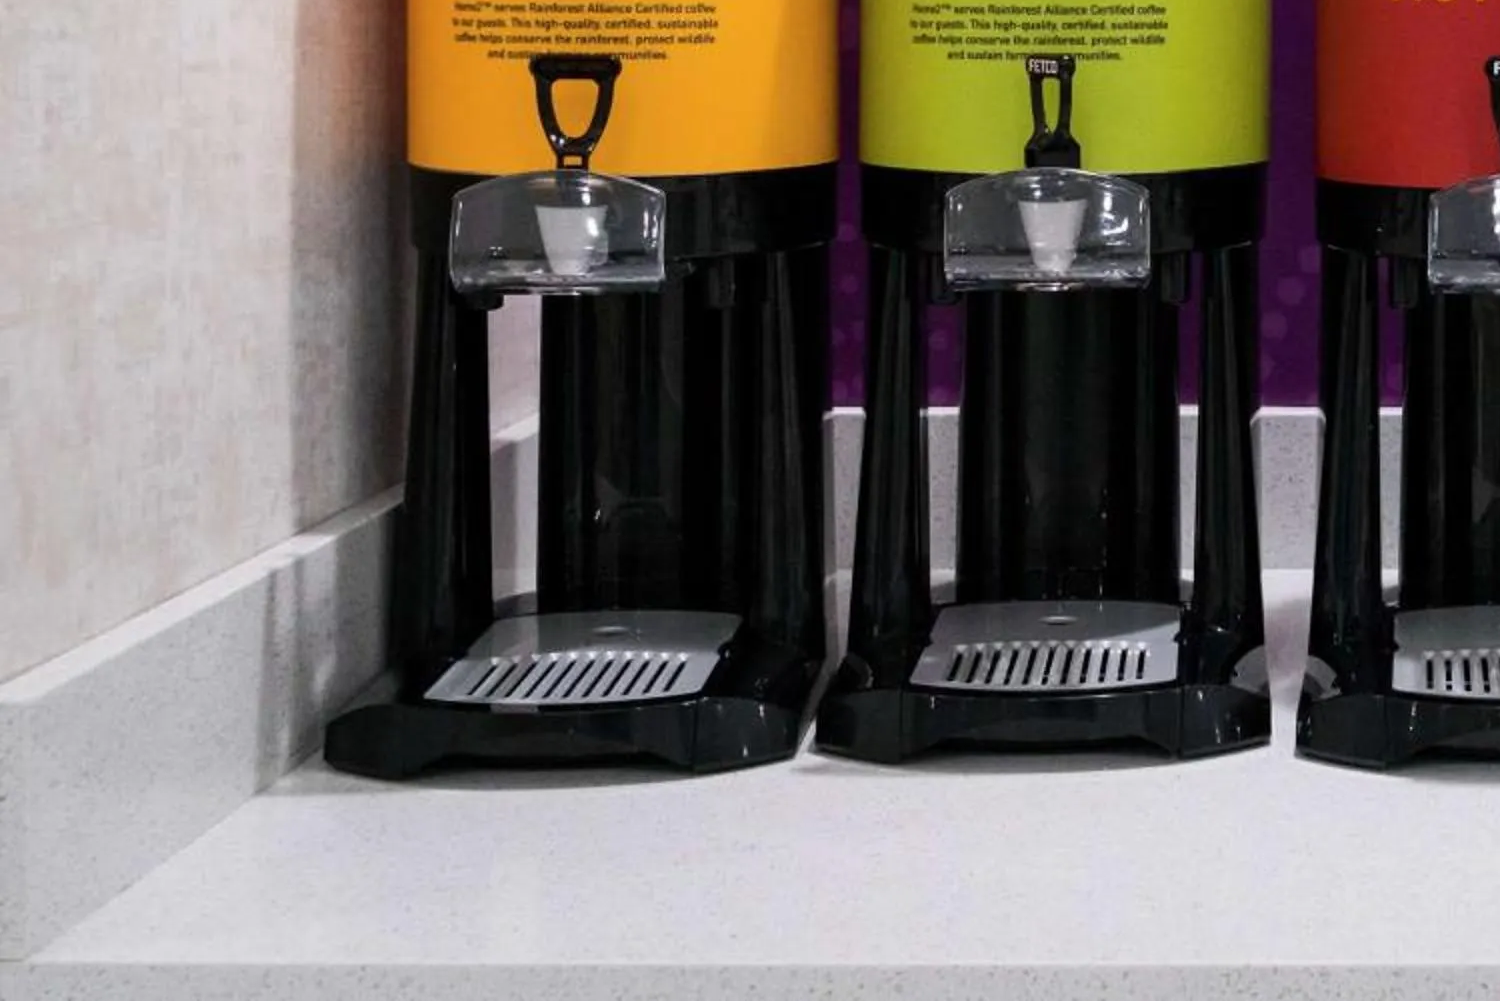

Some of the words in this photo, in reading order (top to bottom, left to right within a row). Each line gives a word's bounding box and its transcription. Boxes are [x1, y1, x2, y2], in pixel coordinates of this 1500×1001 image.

[528, 2, 583, 13] Rainforest
[587, 2, 633, 13] Alliance
[635, 2, 682, 13] Certified
[1045, 4, 1087, 15] Alliance
[1089, 4, 1135, 15] Certified
[657, 19, 719, 29] sustainable
[505, 35, 551, 44] conserve
[554, 34, 570, 43] the
[635, 35, 674, 47] protect
[1013, 35, 1029, 45] the
[1091, 36, 1127, 47] protect
